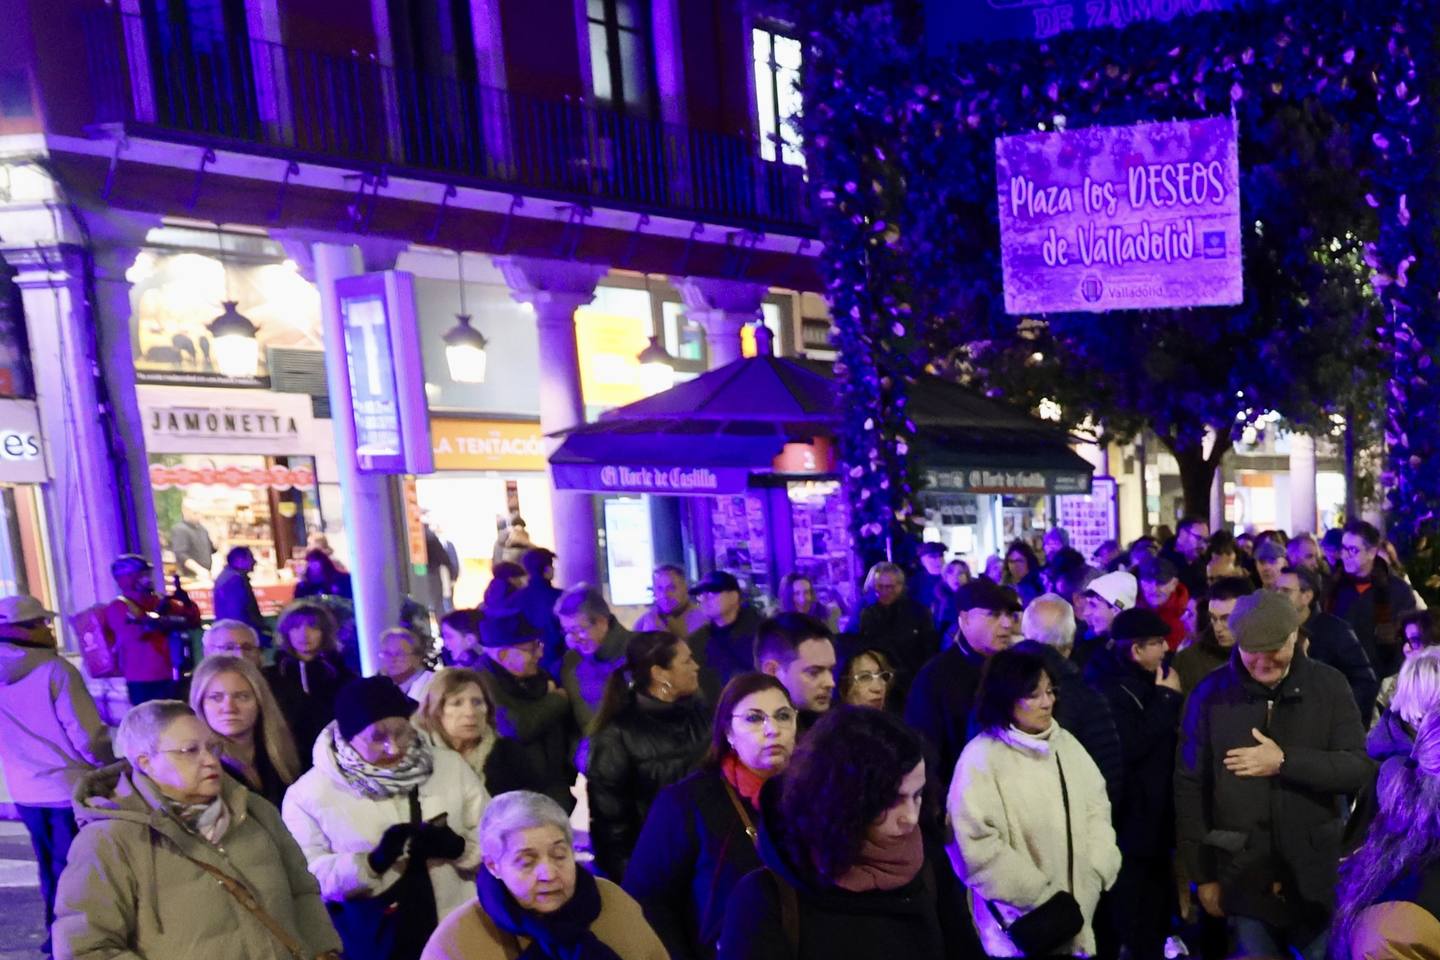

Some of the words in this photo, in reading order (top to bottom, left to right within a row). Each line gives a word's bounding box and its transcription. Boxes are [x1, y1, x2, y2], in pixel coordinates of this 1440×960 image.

[1011, 175, 1072, 218] Plaza
[1083, 176, 1117, 216] los
[1128, 160, 1225, 208] DESEOS
[1042, 226, 1068, 266] de
[1077, 218, 1194, 266] Valladolid
[152, 412, 298, 433] JAMONETTA
